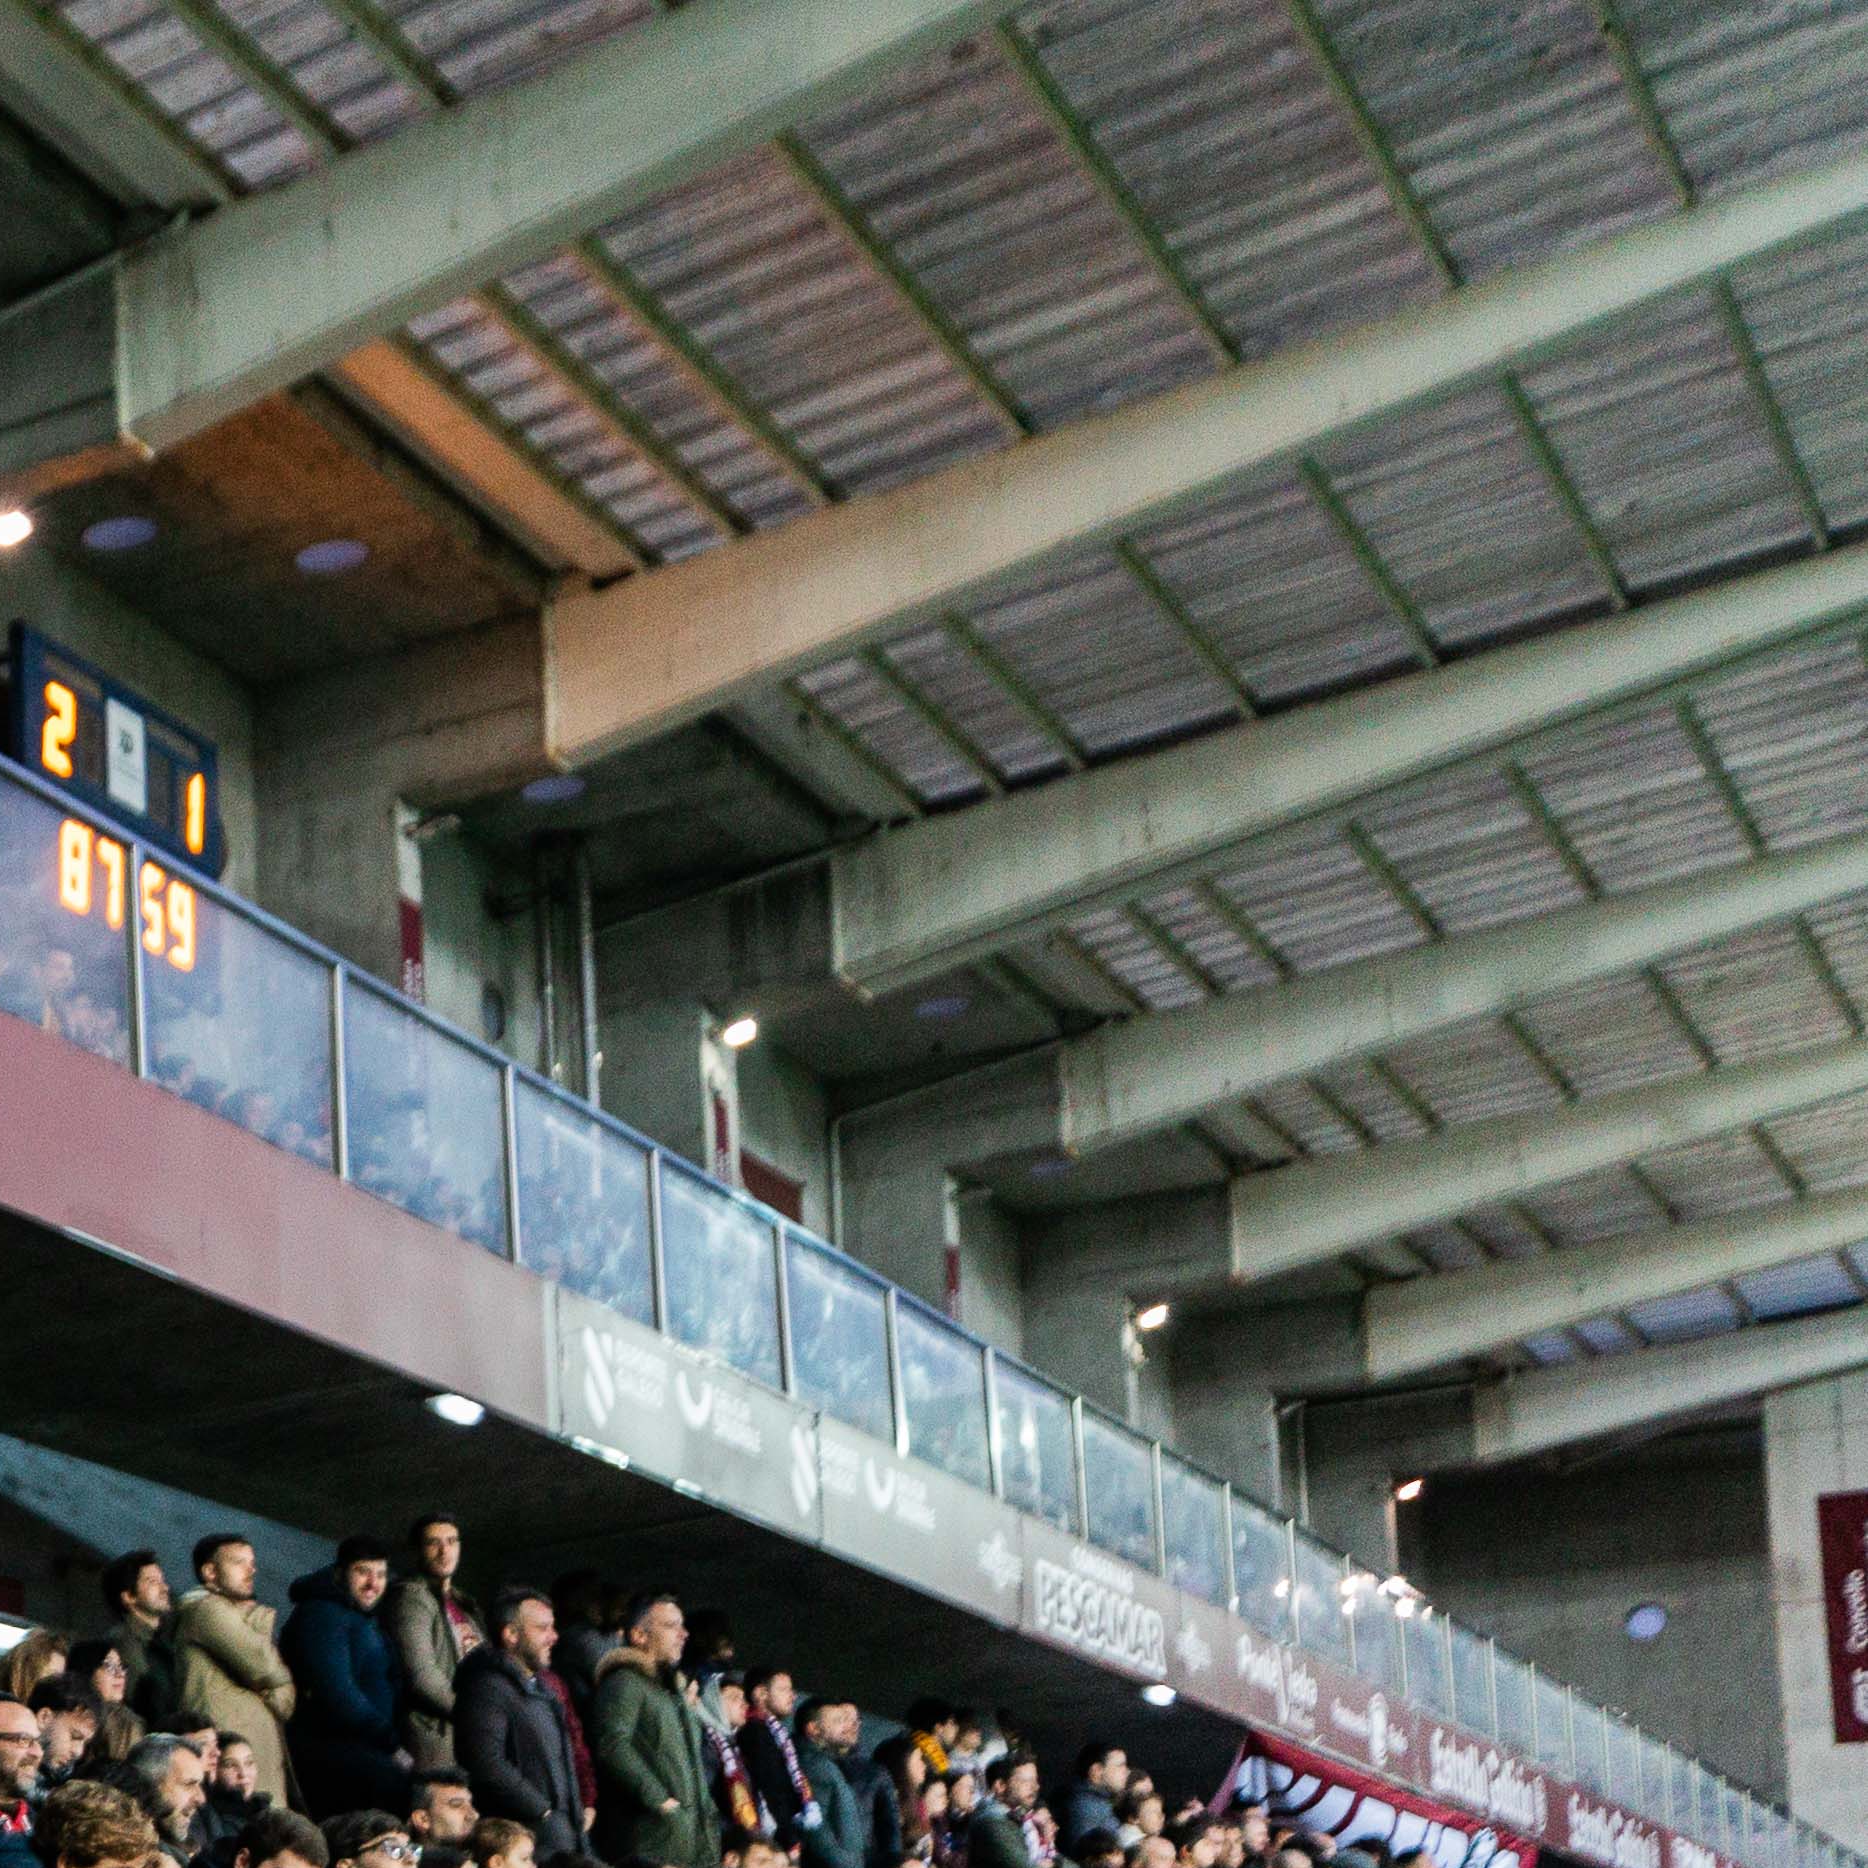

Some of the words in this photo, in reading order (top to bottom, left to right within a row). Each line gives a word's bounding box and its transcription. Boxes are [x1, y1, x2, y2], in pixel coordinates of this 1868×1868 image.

[41, 680, 77, 779] 2
[184, 770, 207, 856] 1
[58, 817, 126, 932] 87
[139, 860, 198, 972] 59
